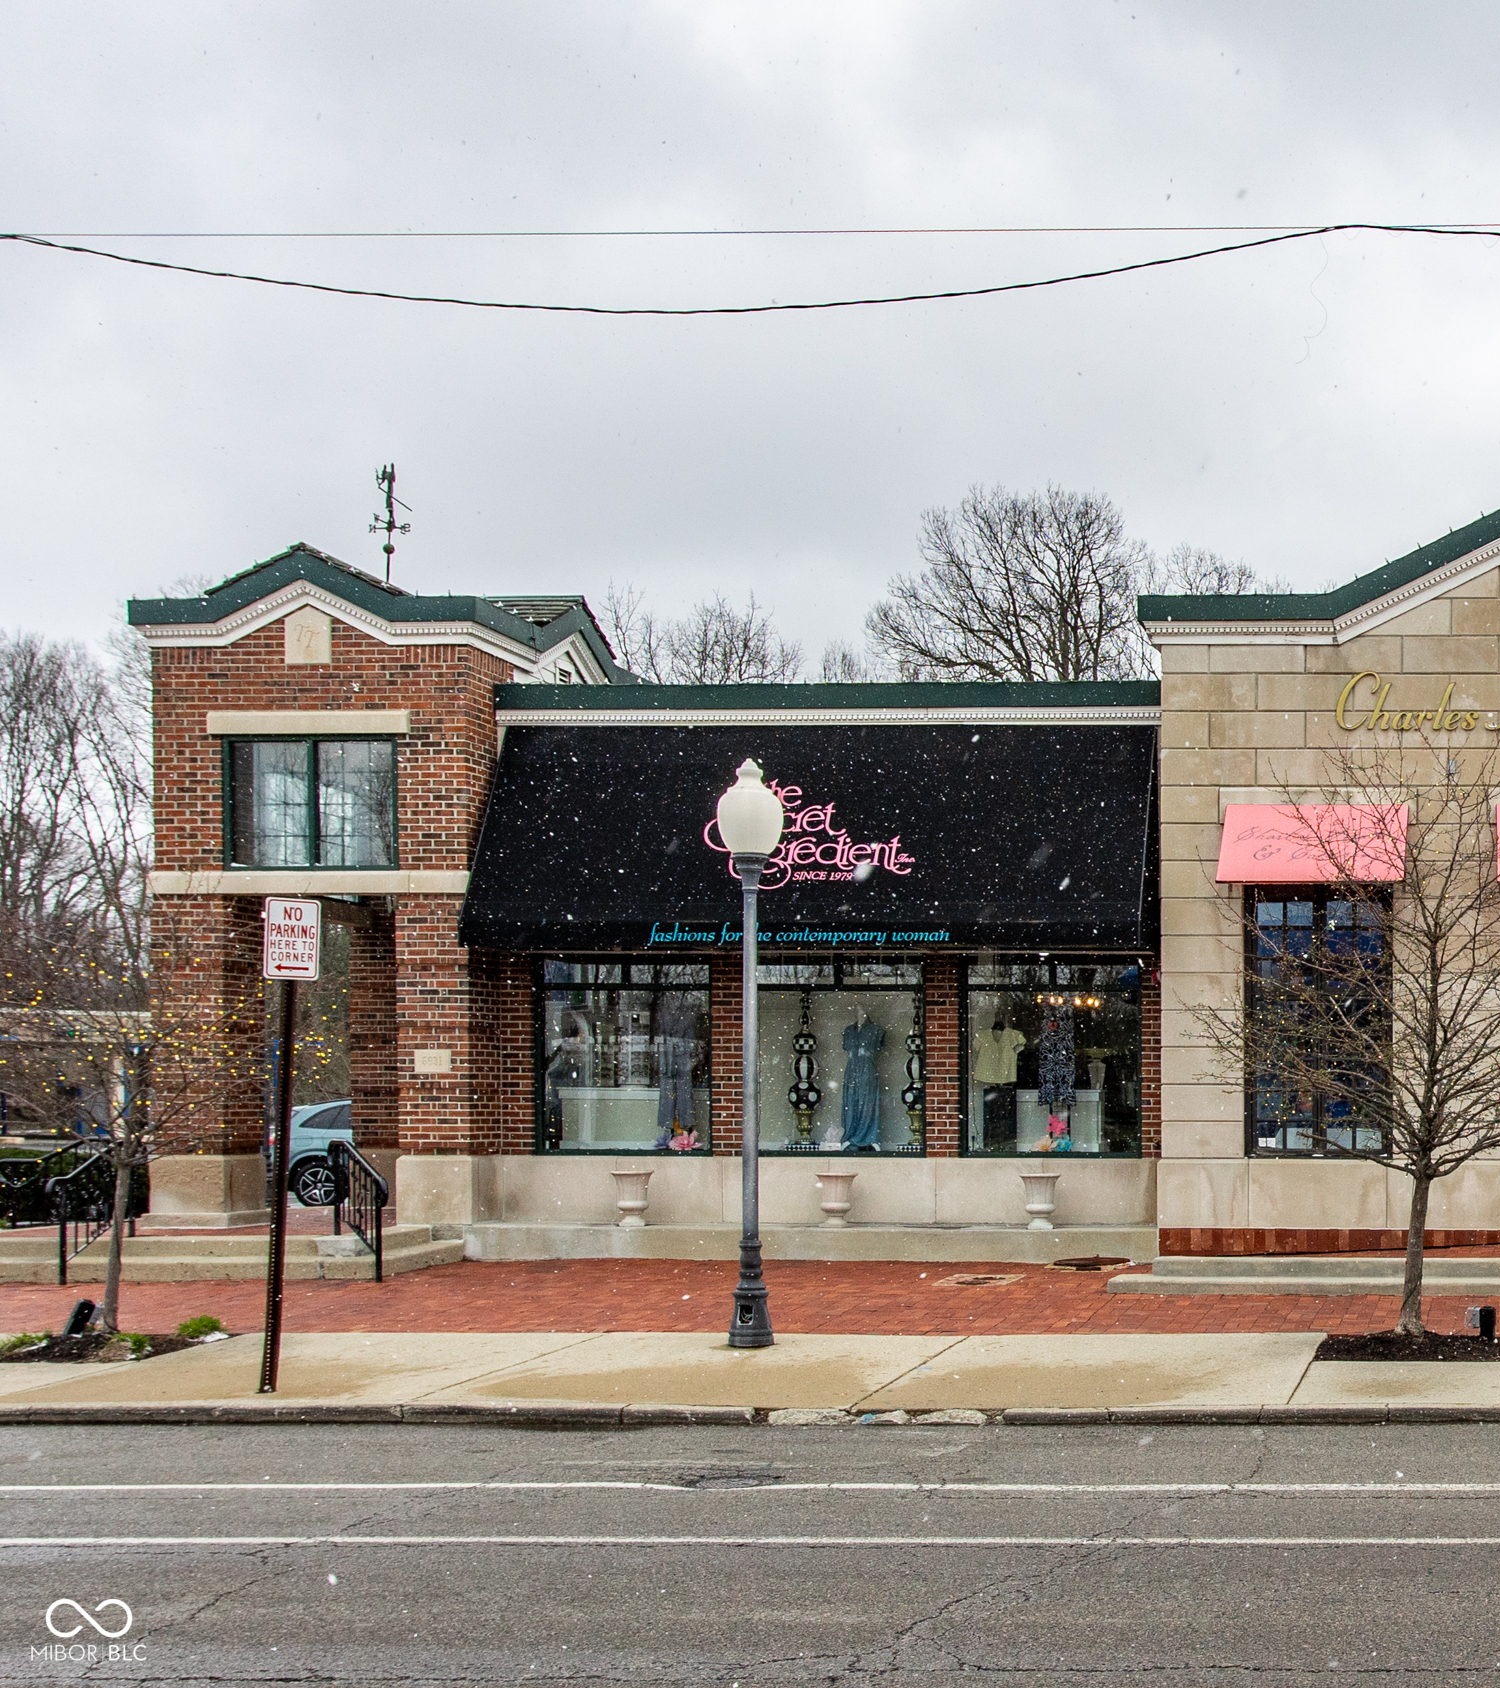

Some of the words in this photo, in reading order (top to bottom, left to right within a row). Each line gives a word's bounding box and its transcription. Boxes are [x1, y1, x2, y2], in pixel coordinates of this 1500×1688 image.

[1335, 670, 1479, 731] Charles
[763, 779, 803, 807] he
[729, 834, 913, 890] gredient
[792, 871, 827, 881] SINCE
[828, 871, 854, 881] 1979
[283, 906, 303, 922] NO
[269, 922, 316, 940] PARKING
[647, 922, 716, 946] fashions
[717, 922, 744, 946] for
[755, 921, 773, 942] he
[776, 927, 887, 946] contemporary
[891, 930, 951, 942] woman
[269, 939, 298, 951] HERE
[301, 940, 315, 952] TO
[270, 950, 314, 963] CORNER
